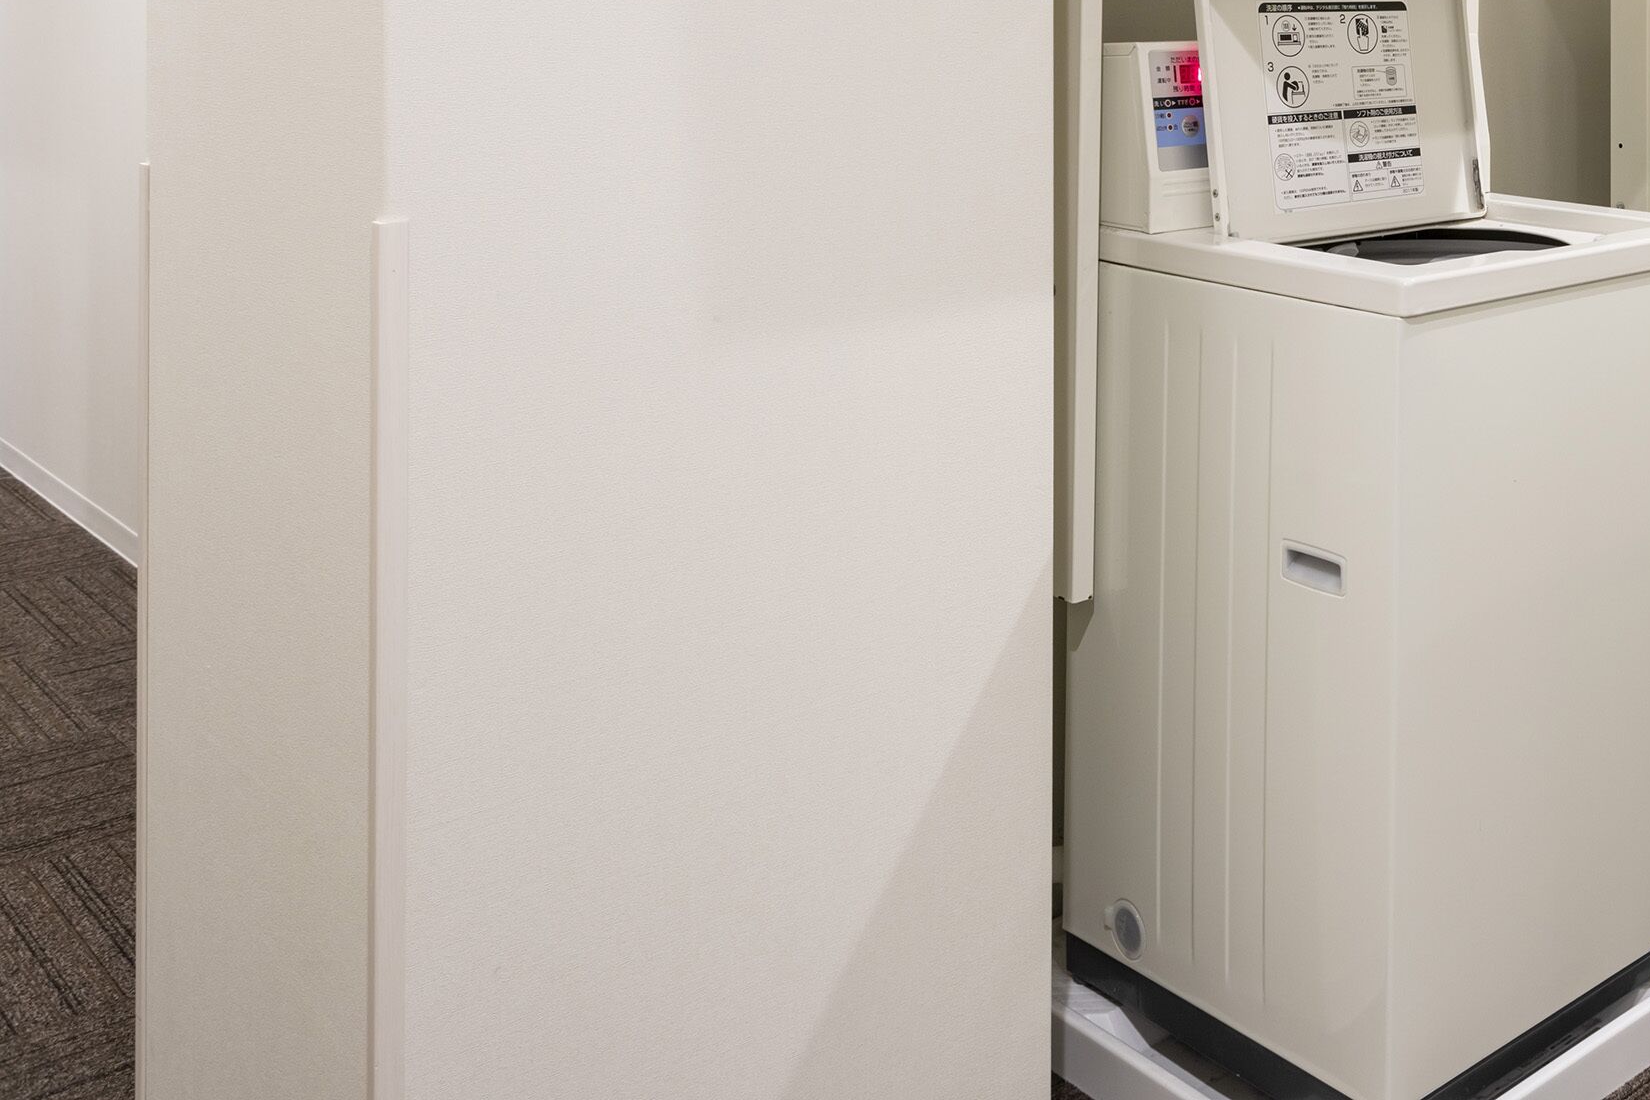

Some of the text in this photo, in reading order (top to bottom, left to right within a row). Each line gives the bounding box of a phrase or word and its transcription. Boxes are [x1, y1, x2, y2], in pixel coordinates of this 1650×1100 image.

[1264, 14, 1346, 25] 1 2
[1267, 62, 1275, 72] 3
[1271, 114, 1339, 124] 硬貨を投入するときのご注意
